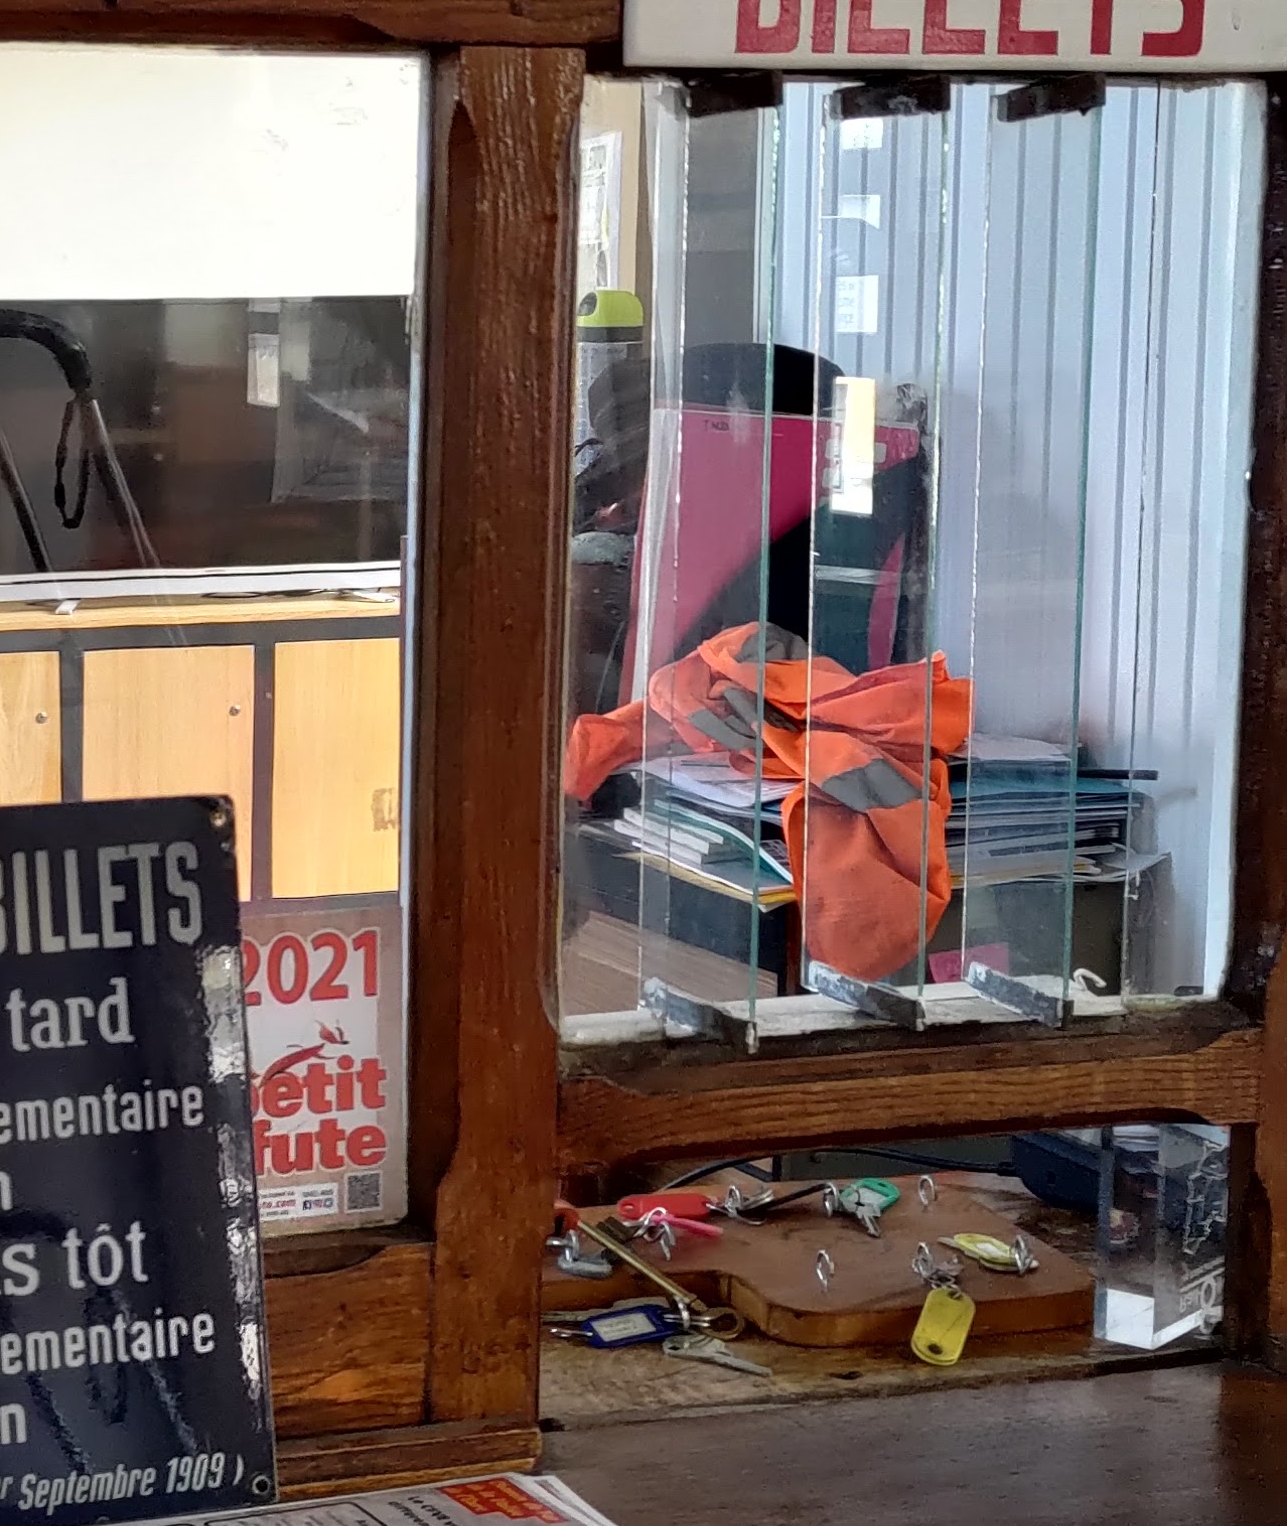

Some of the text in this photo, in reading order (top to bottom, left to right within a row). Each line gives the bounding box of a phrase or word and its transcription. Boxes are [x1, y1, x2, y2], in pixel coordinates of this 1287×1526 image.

[6, 978, 134, 1052] tard
[62, 1221, 148, 1289] tôt
[18, 1461, 156, 1517] Septembre
